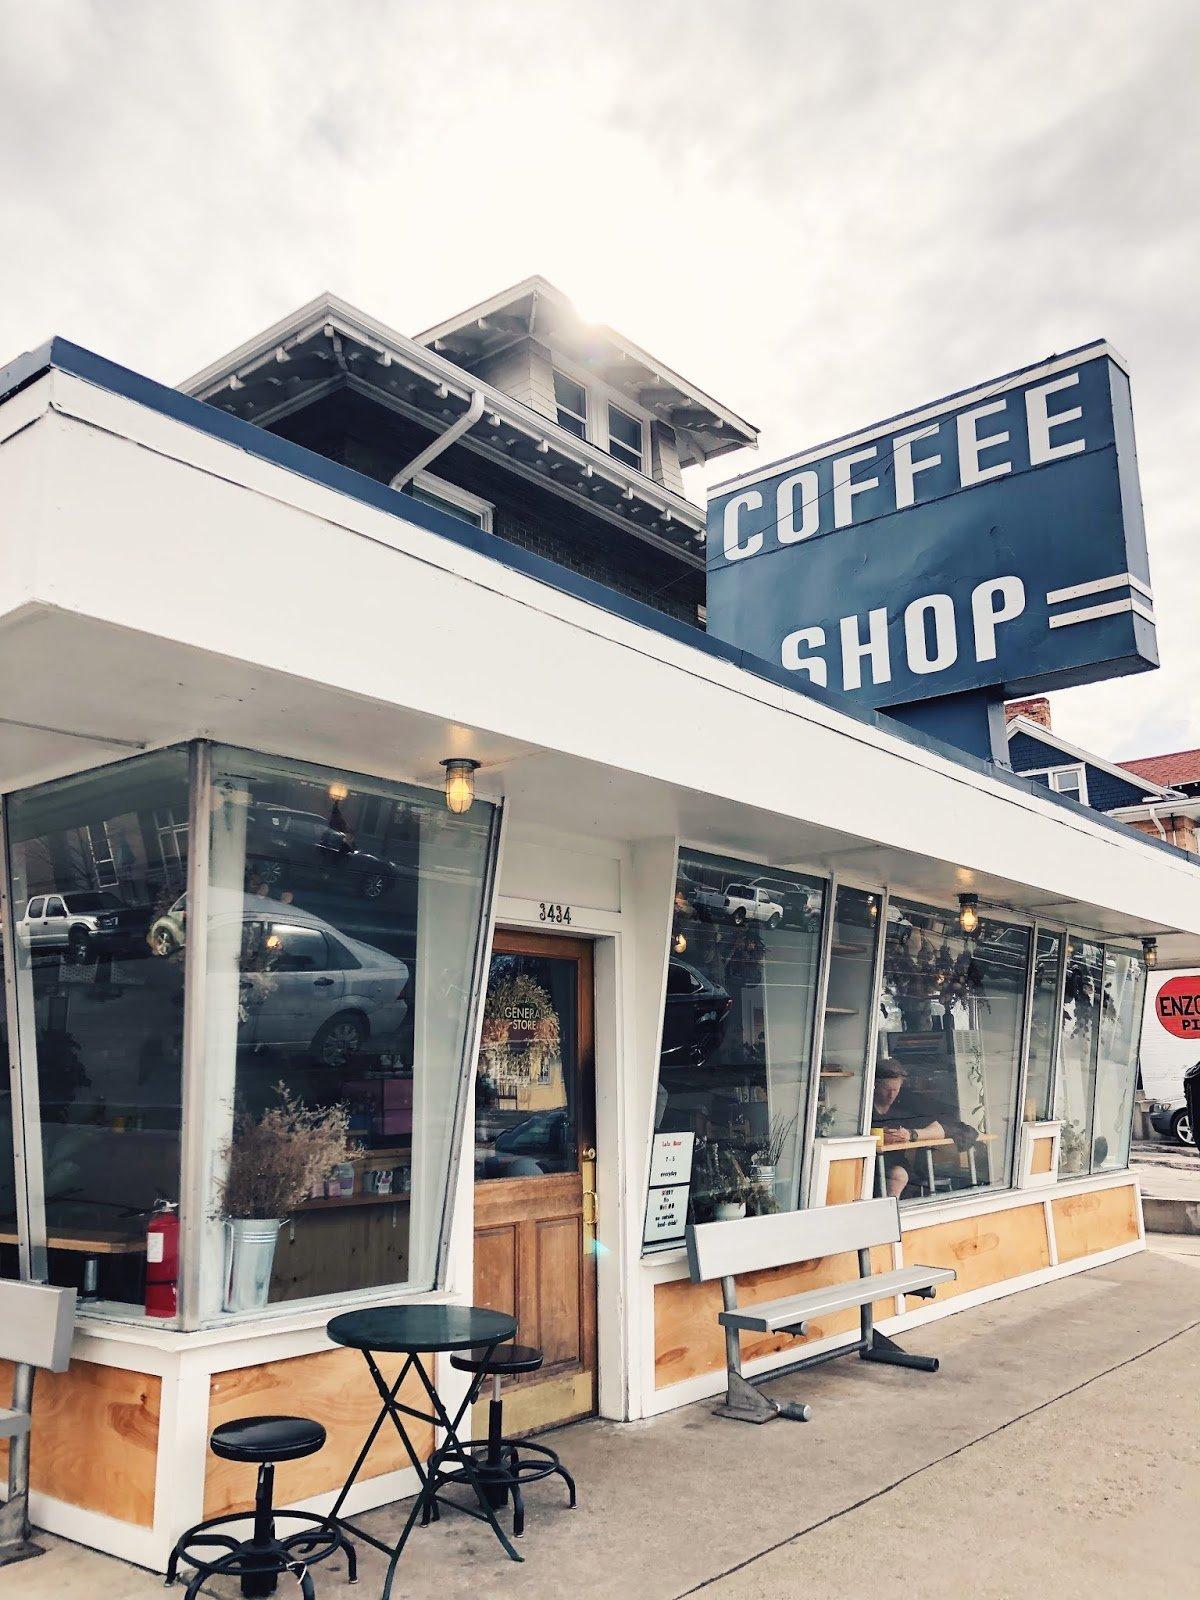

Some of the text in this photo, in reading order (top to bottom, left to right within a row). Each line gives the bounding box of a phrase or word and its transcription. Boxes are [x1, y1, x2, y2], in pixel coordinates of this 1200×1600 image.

[723, 371, 1086, 561] COFFEE
[781, 575, 1026, 691] SHOP
[539, 902, 572, 925] 3434
[513, 1019, 537, 1030] STORE
